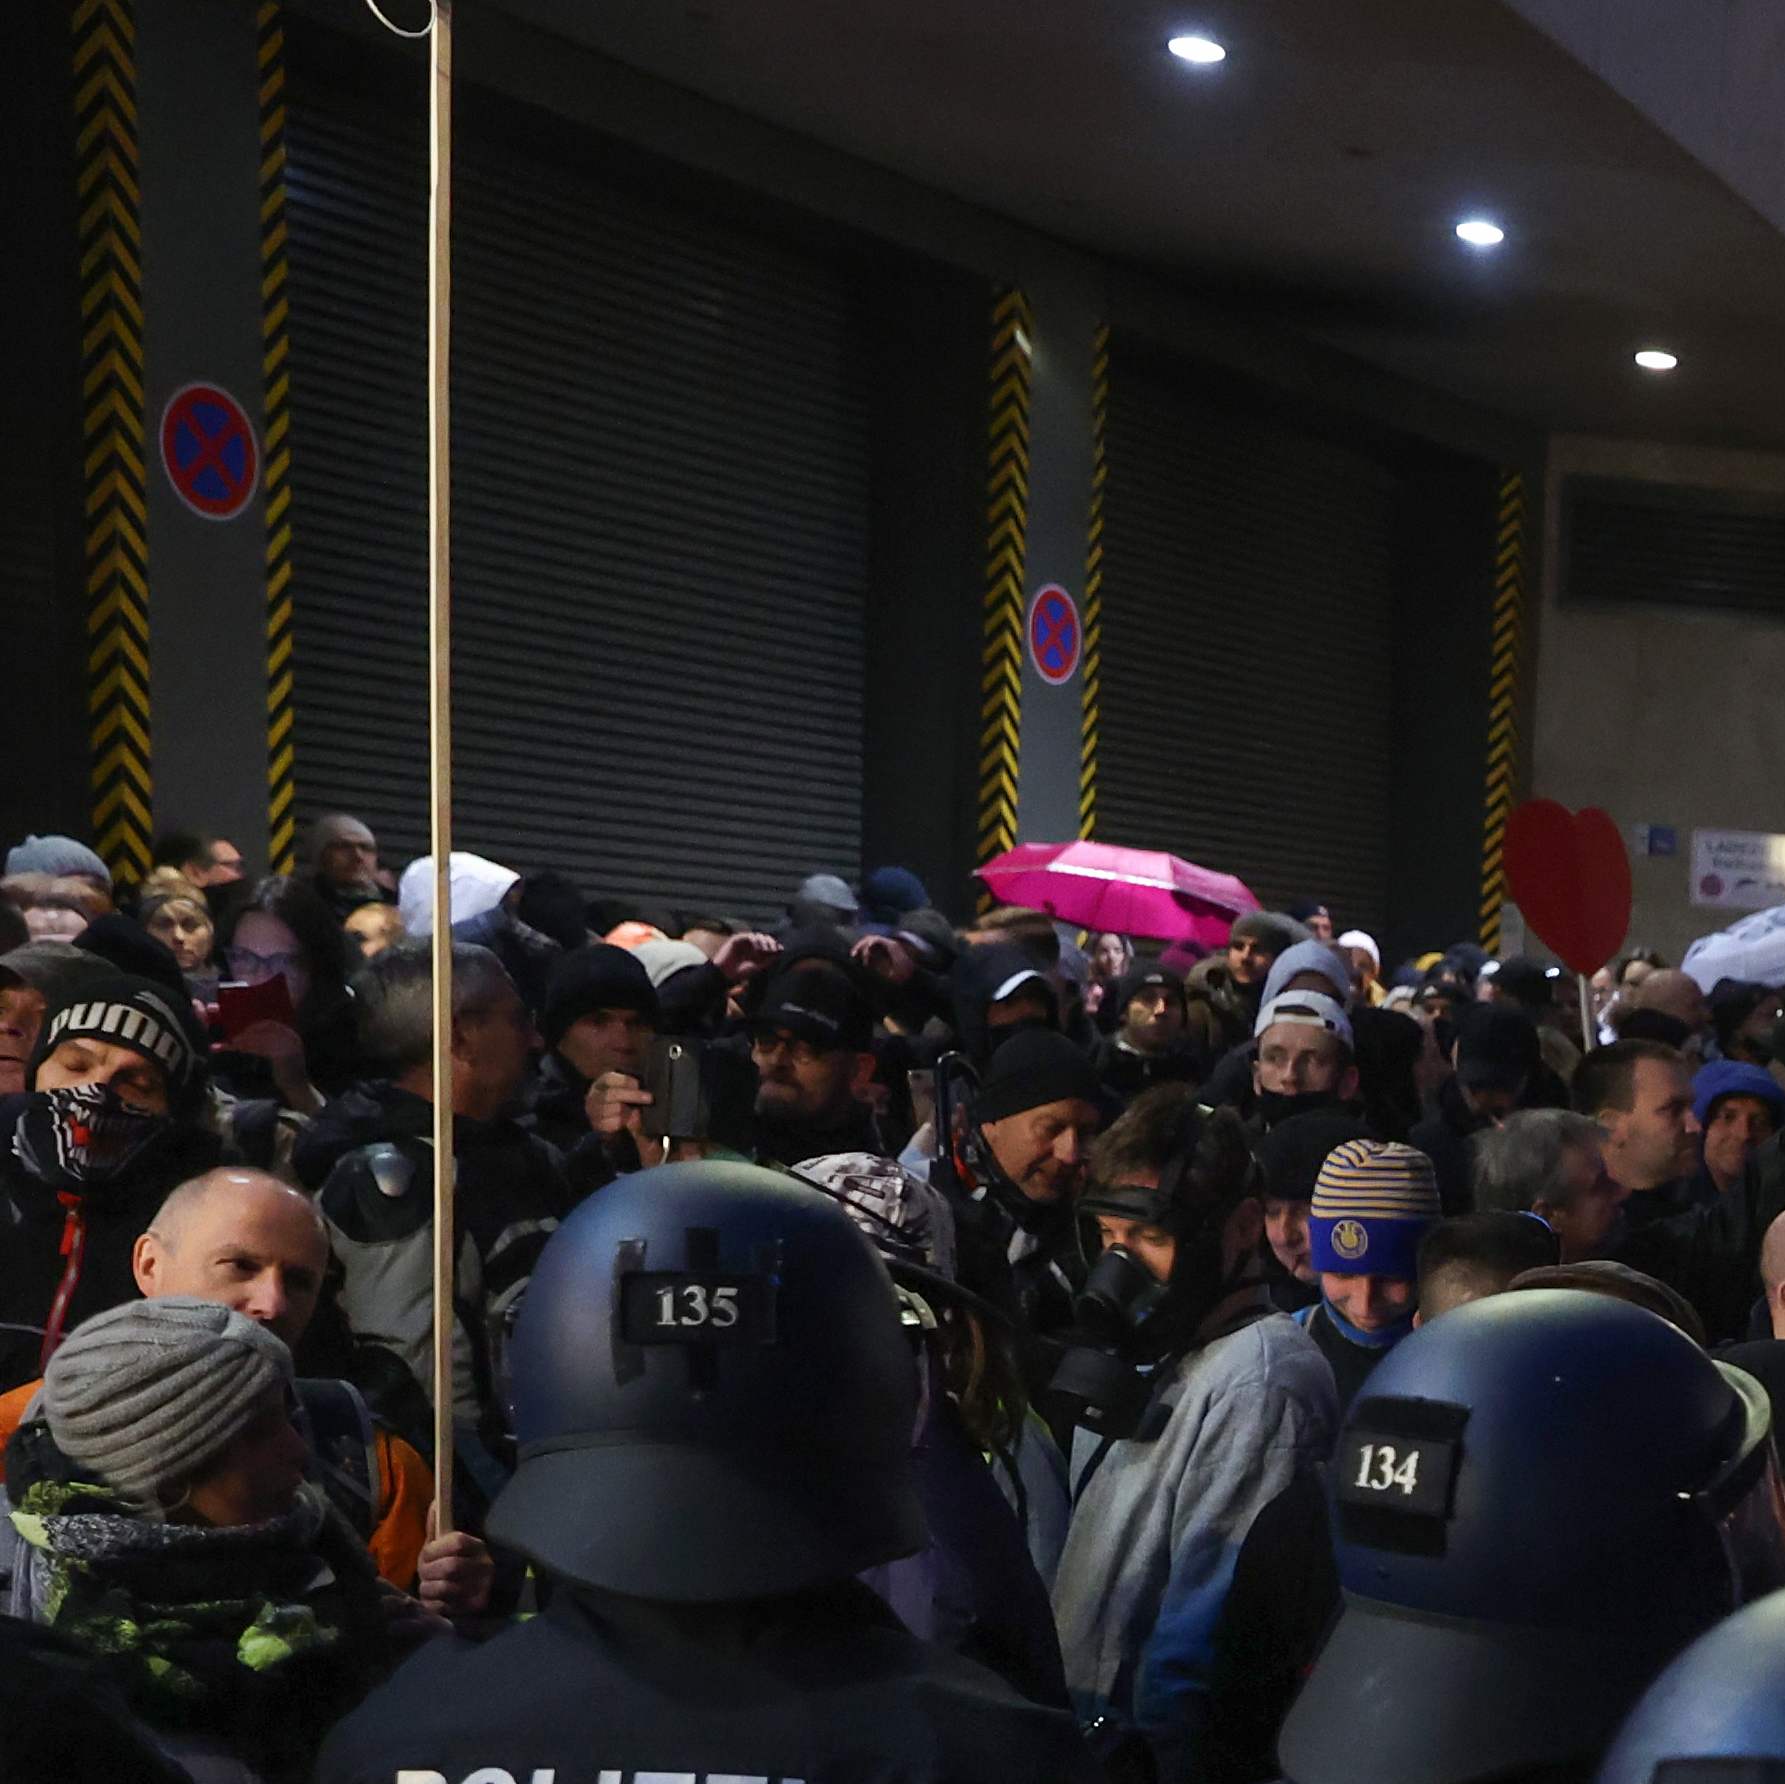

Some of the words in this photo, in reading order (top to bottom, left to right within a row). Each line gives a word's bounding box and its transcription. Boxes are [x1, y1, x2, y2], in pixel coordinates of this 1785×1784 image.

[47, 1001, 184, 1073] PUMA
[655, 1284, 739, 1328] 135
[1353, 1443, 1420, 1495] 134
